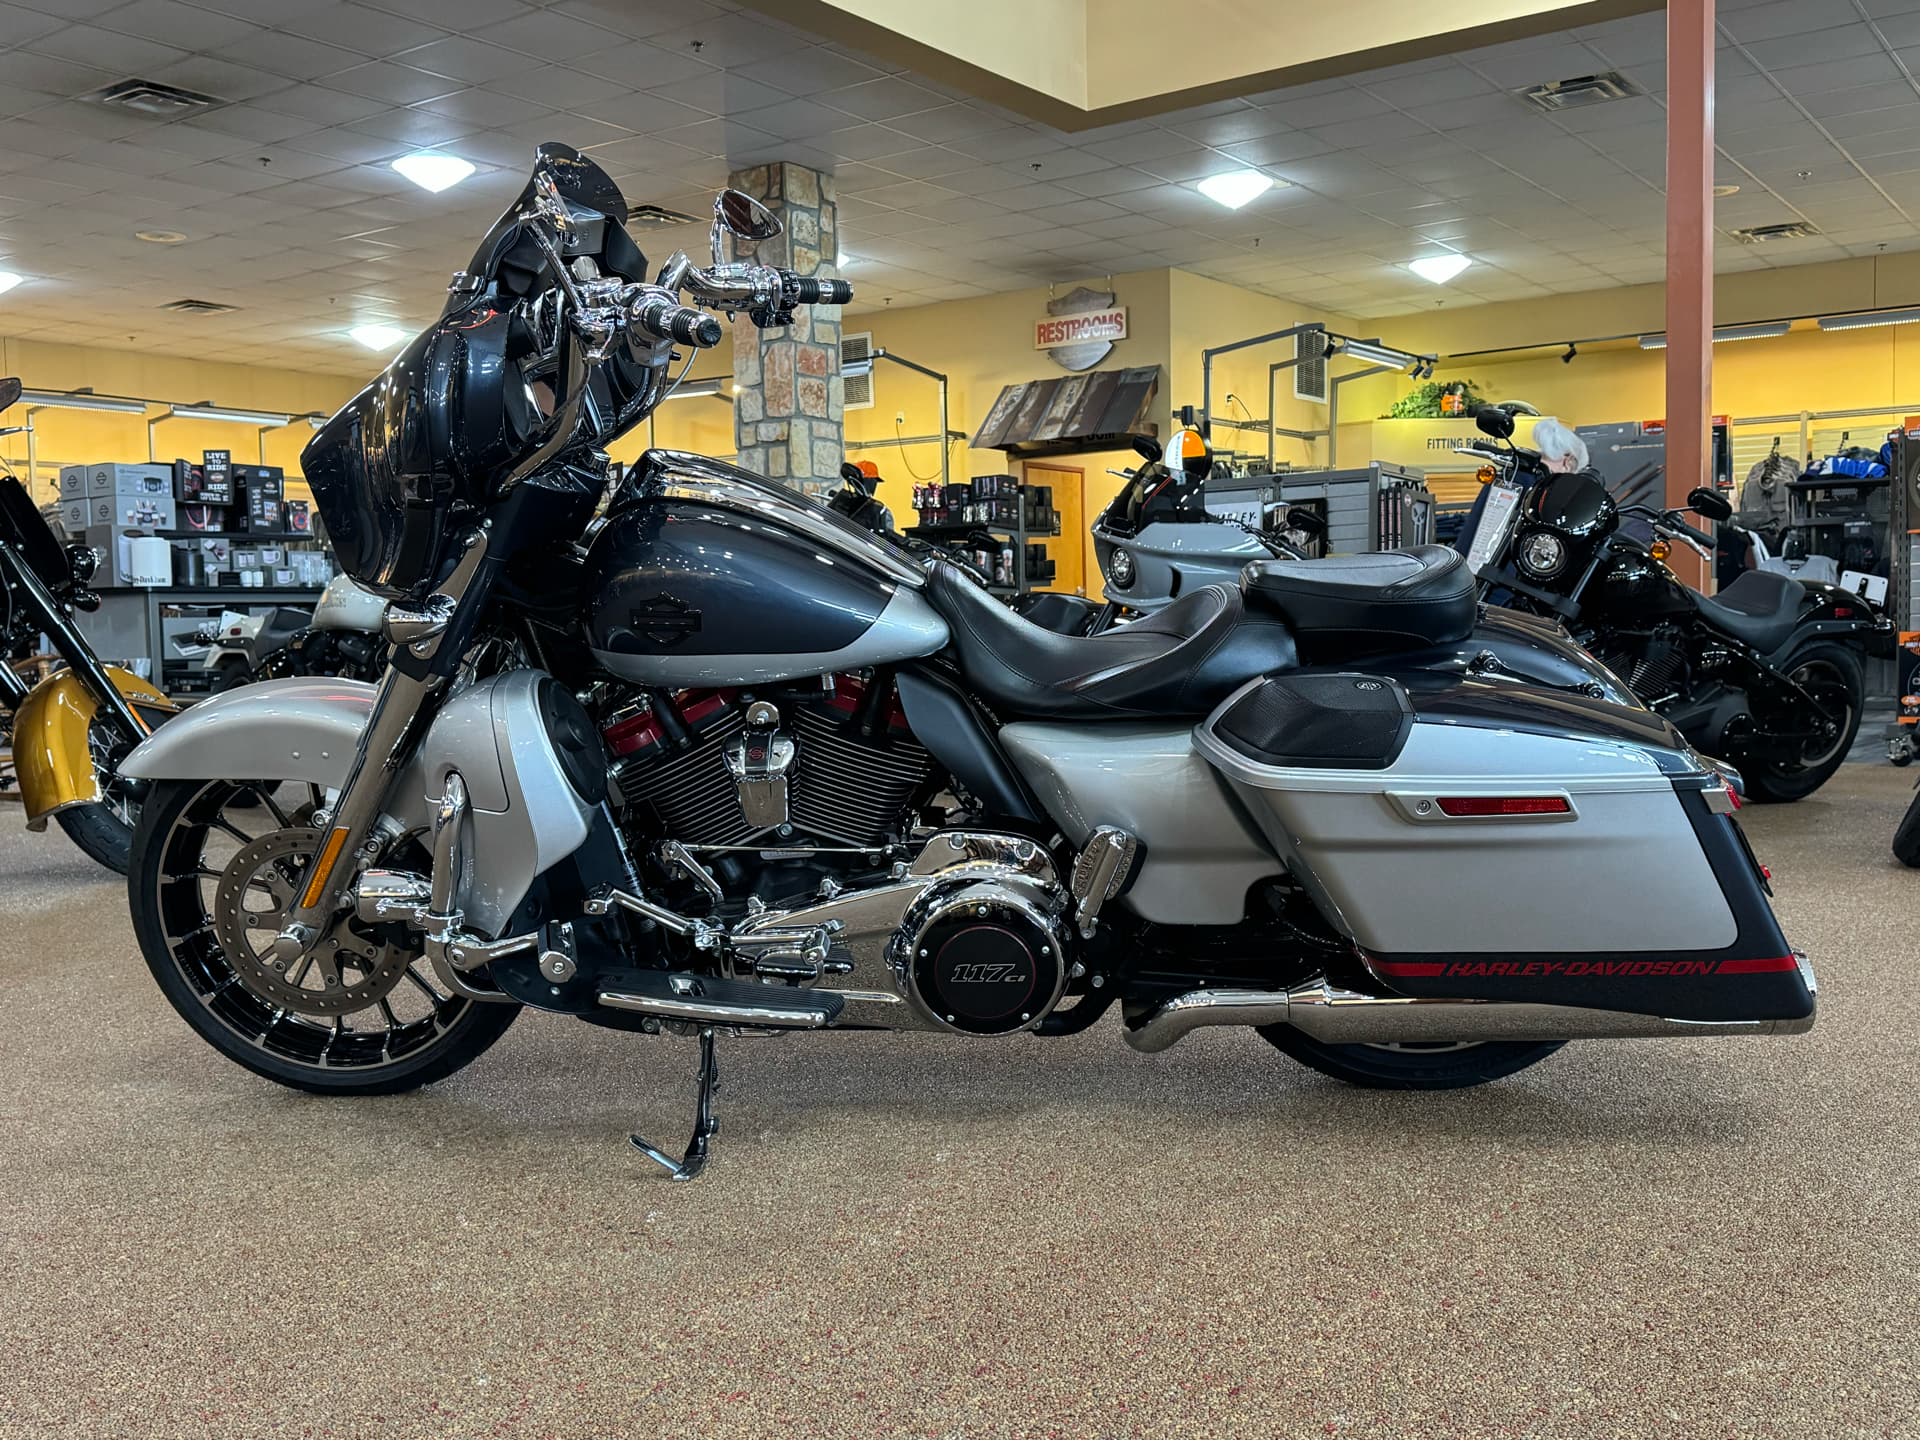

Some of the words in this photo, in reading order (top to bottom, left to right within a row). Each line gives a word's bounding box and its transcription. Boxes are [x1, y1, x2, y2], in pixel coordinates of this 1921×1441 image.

[1037, 312, 1124, 345] RESTROOMS
[1427, 438, 1463, 449] FITTING
[1446, 961, 1716, 977] HARLEY-DAVIDSON
